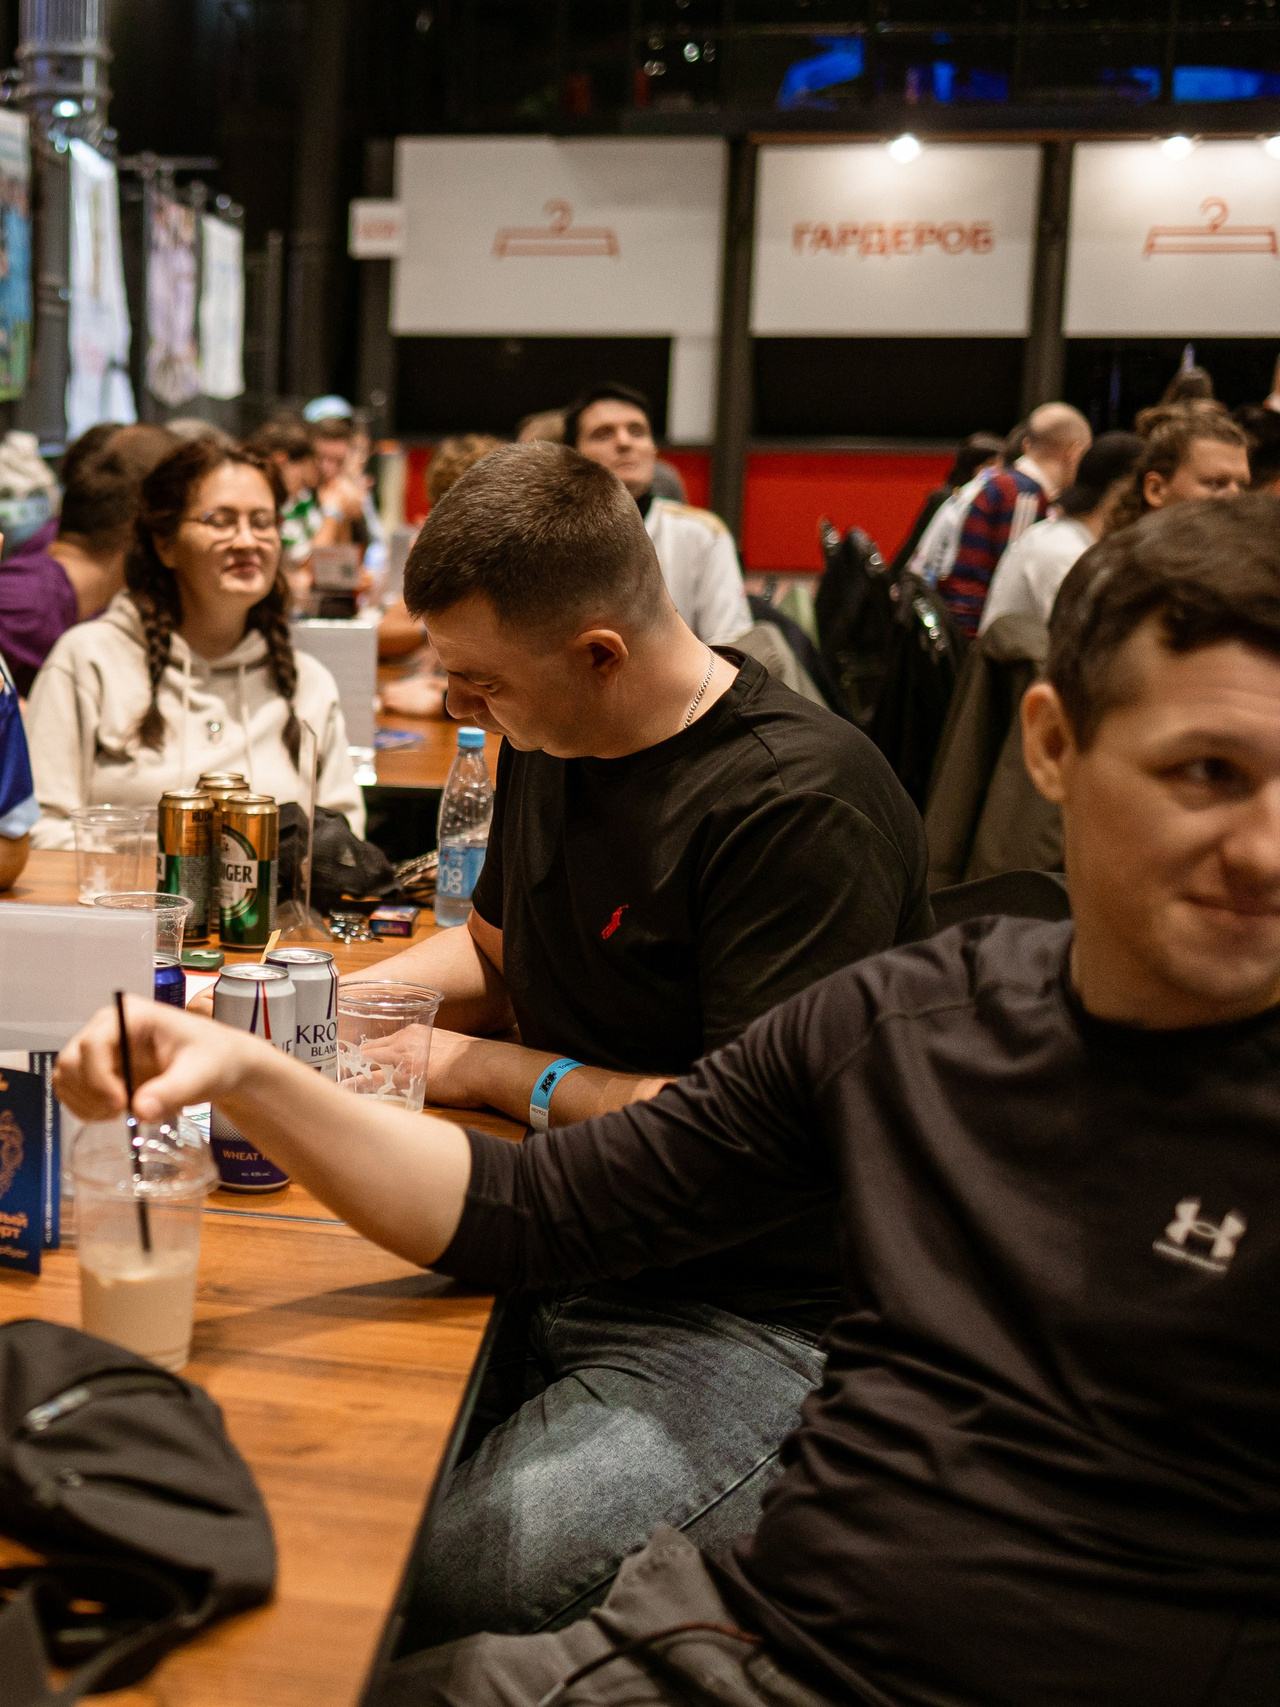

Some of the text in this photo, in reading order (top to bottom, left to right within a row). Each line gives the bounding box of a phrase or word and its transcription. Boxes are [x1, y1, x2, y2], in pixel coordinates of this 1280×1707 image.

[792, 220, 995, 260] ГАРДЕРОБ
[295, 1021, 338, 1045] KRO
[223, 1149, 260, 1162] WHEAT
